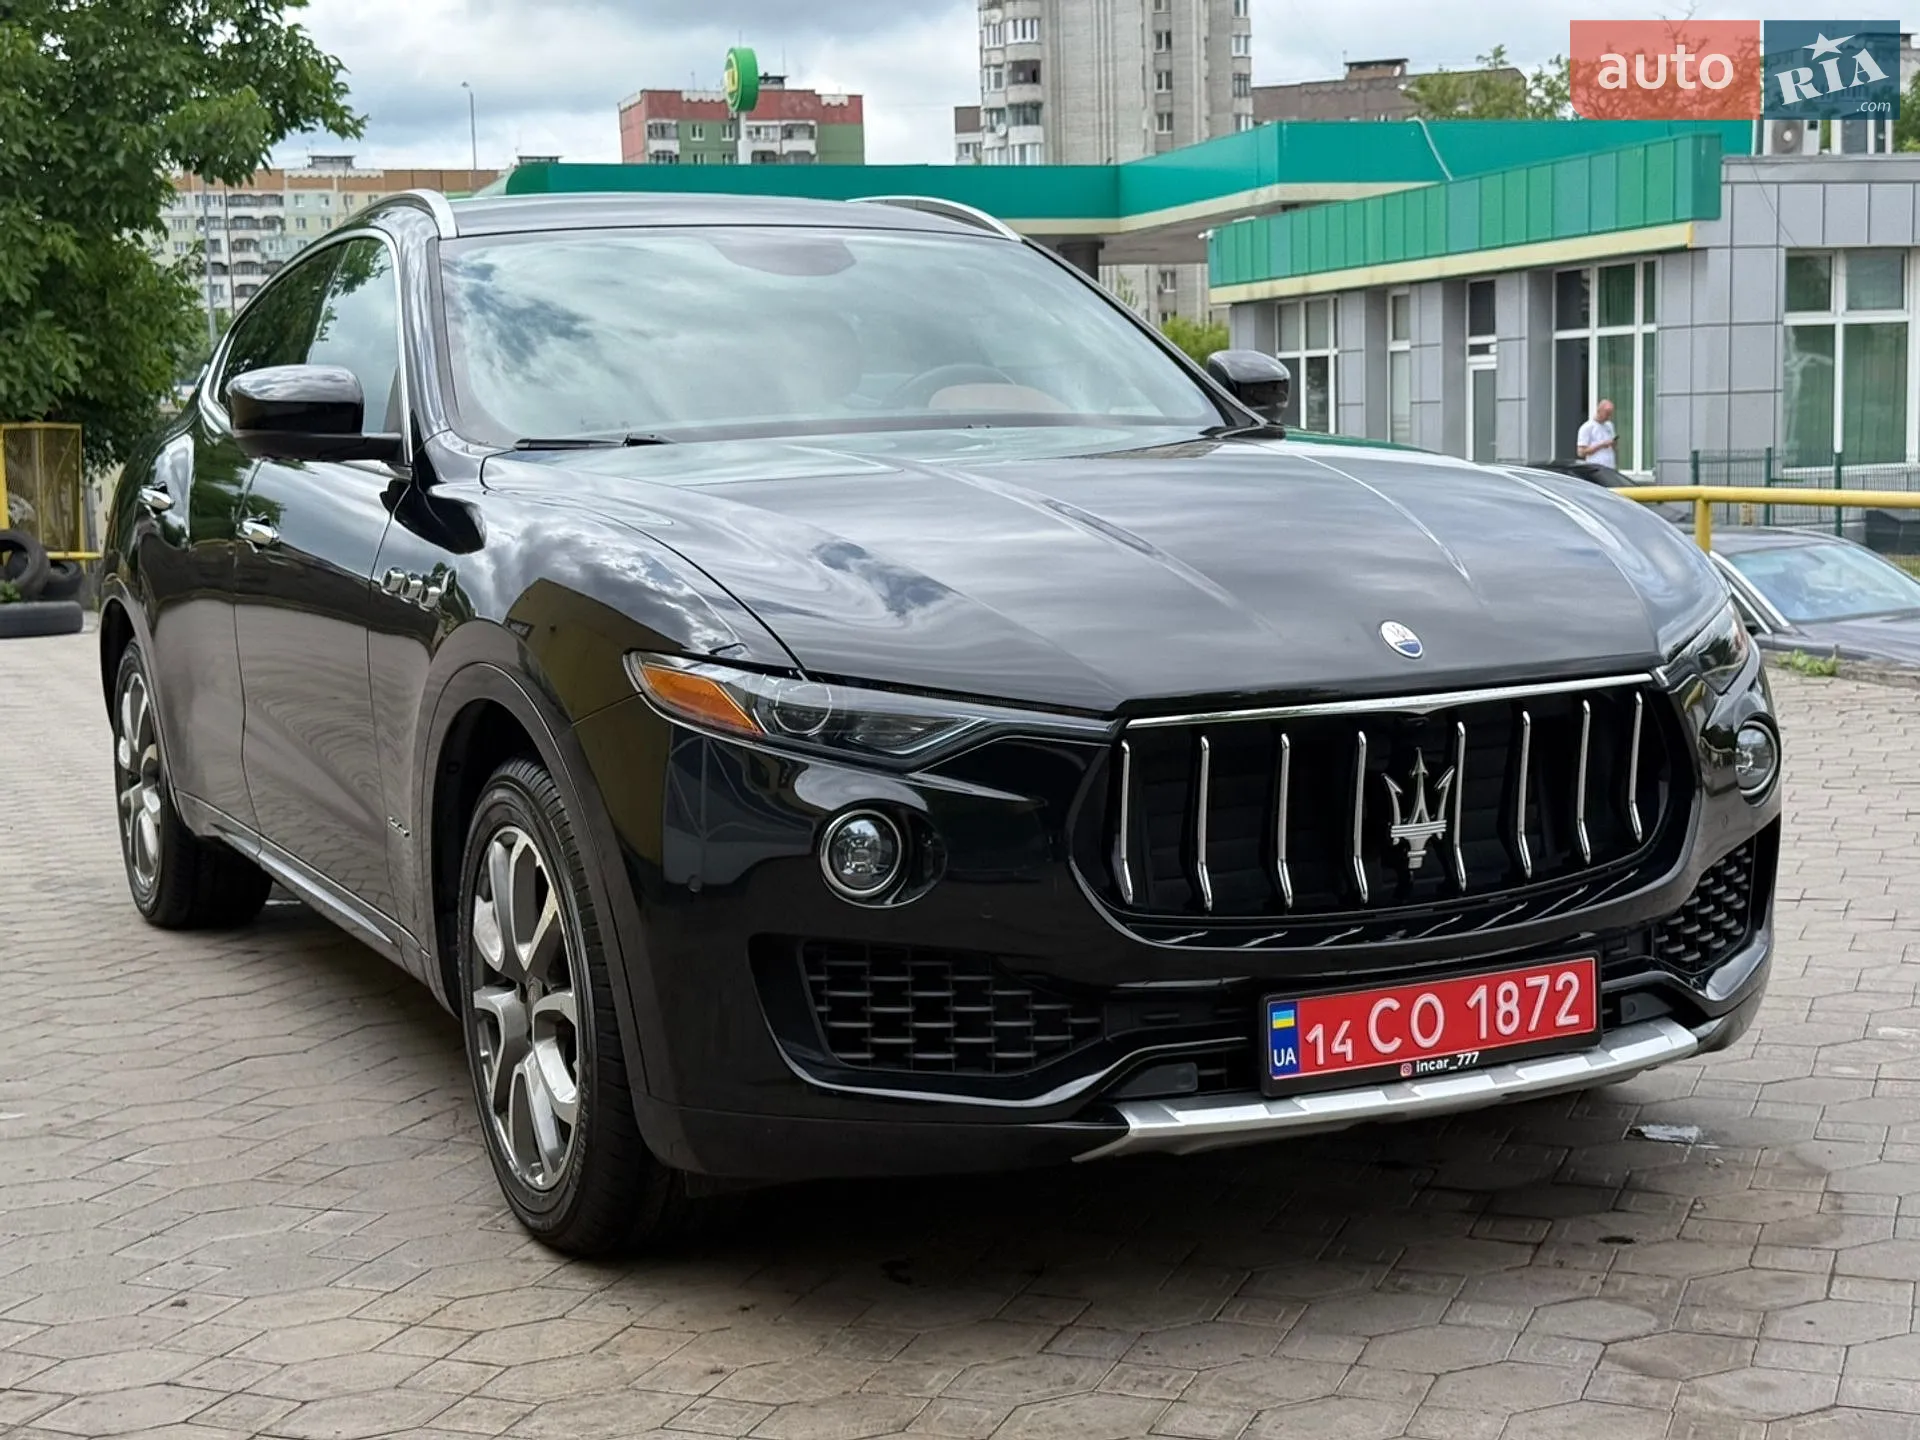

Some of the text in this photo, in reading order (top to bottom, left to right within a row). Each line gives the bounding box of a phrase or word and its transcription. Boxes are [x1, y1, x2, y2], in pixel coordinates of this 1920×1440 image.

[1305, 971, 1580, 1065] 14 CO 1872
[1273, 1047, 1296, 1067] UA
[1416, 1051, 1480, 1073] incar_777
